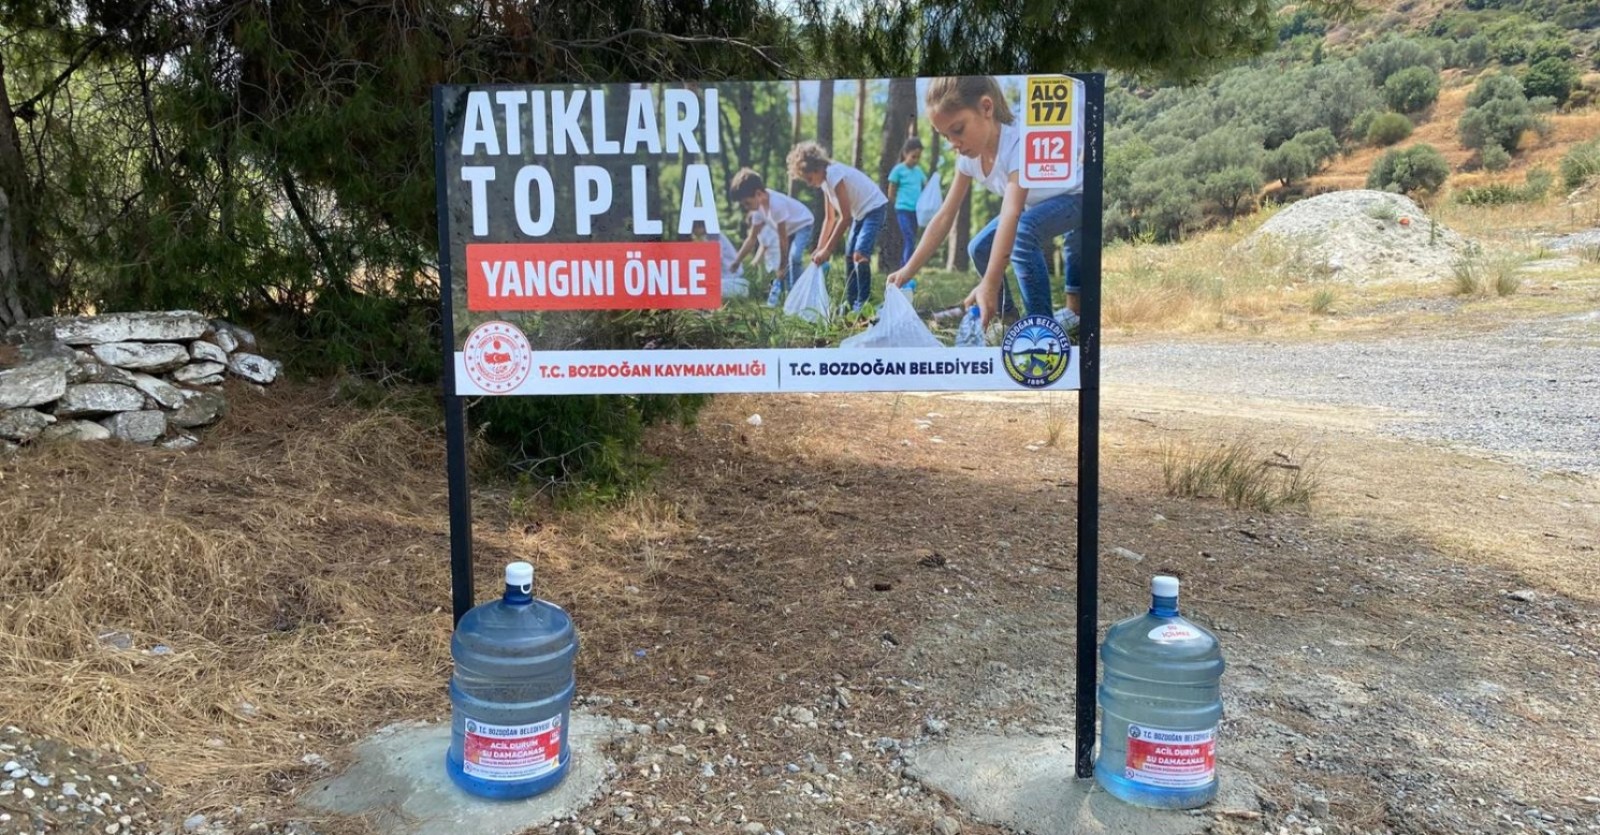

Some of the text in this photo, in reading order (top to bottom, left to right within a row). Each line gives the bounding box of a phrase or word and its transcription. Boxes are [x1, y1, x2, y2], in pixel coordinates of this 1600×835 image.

[1031, 85, 1068, 101] ALO
[461, 88, 720, 156] ATIKLARI
[1031, 102, 1068, 122] 177
[1032, 136, 1065, 160] 112
[461, 164, 721, 237] TOPLA
[481, 251, 707, 297] YANGINI ÖNLE
[539, 366, 565, 378] T.C.
[568, 361, 651, 378] BOZDOĞAN
[655, 360, 766, 377] KAYMAKAMLIĞI
[789, 358, 993, 376] T.C. BOZDOĞAN BELEDİYESİ
[1146, 755, 1157, 763] SU
